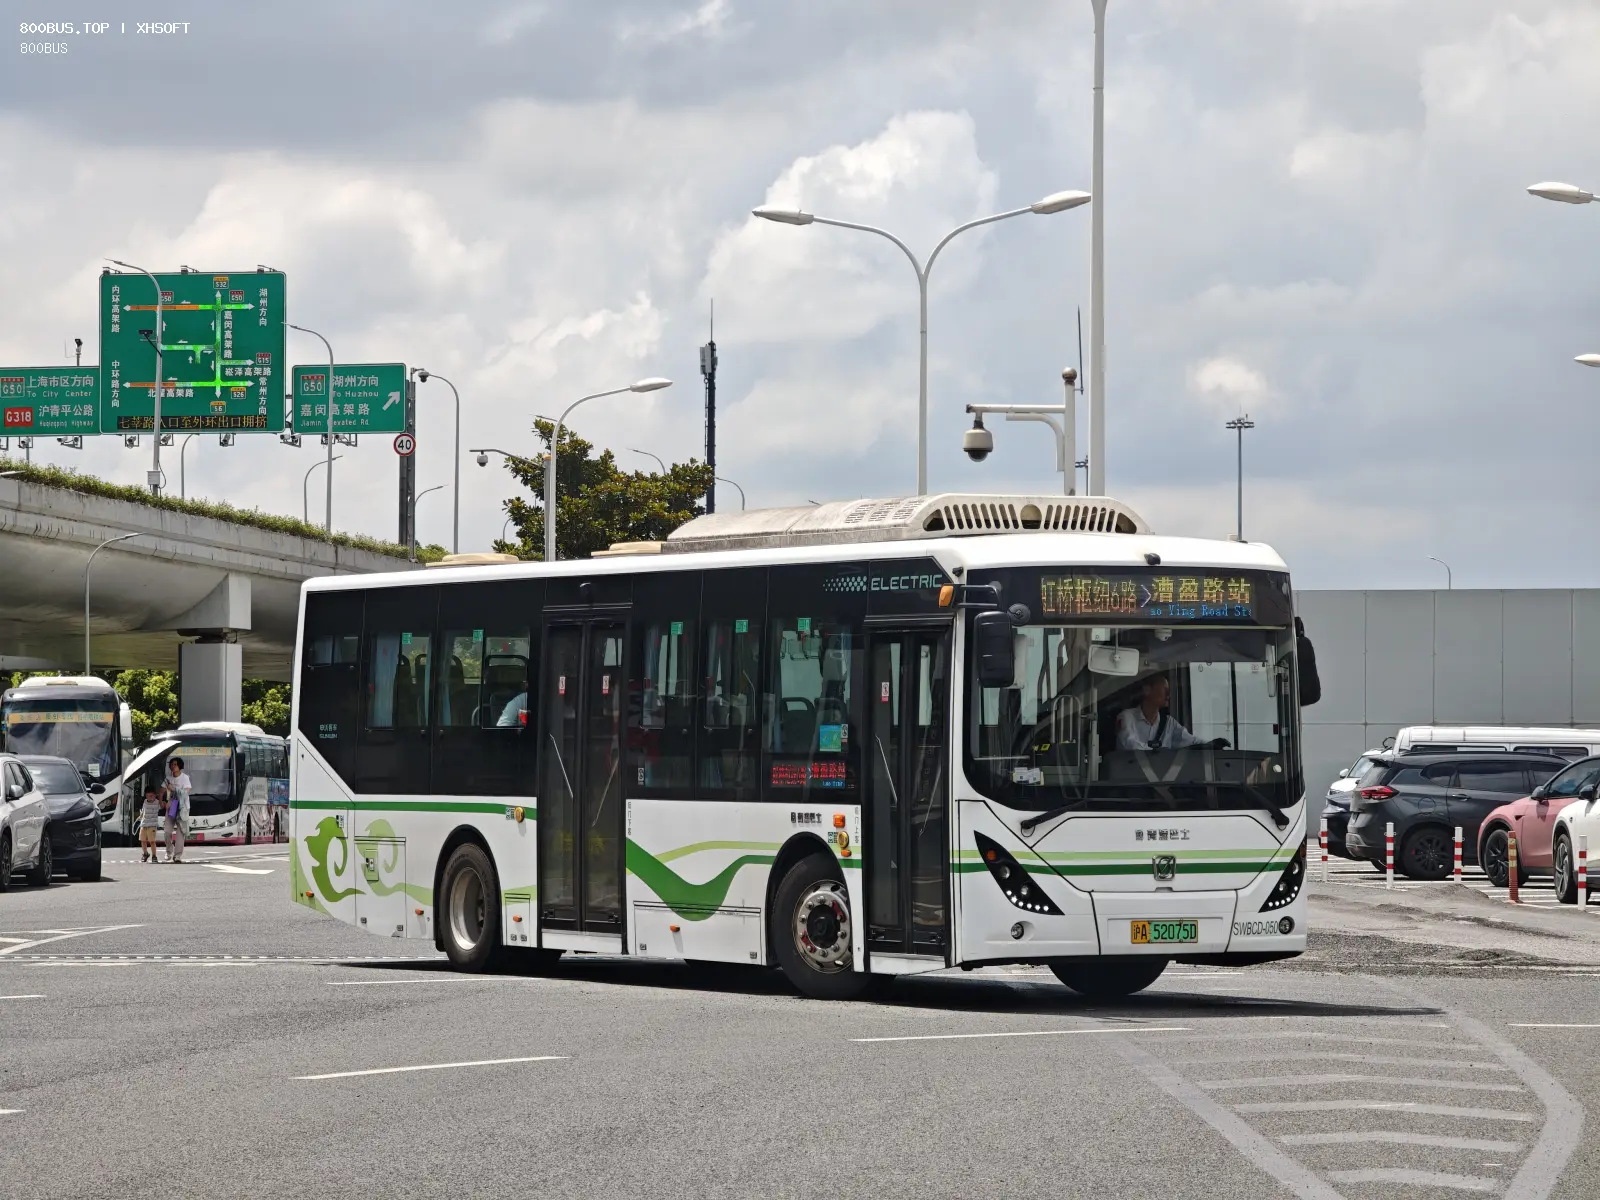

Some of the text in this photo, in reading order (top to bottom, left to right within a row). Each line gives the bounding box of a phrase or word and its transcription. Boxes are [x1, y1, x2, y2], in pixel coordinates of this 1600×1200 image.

[111, 285, 120, 333] 内环高架路
[259, 288, 268, 327] 湖州方向
[224, 310, 233, 359] 嘉闵高架路
[26, 375, 94, 388] 上海市区方向
[111, 360, 120, 408] 中环路方向
[303, 382, 323, 392] G50
[332, 375, 379, 387] 湖州方向
[2, 384, 22, 395] G50
[43, 390, 59, 398] City
[258, 377, 267, 415] 常州方向
[38, 404, 94, 417] 沪青平公路
[300, 403, 370, 416] 嘉闵高架路
[6, 410, 32, 423] G318
[300, 419, 322, 427] Jiamin
[327, 418, 357, 426] evated
[397, 439, 412, 450] 40
[871, 574, 943, 591] ELECTRIC
[1169, 604, 1196, 618] Ying
[1201, 604, 1229, 616] Road
[1153, 923, 1197, 940] 52075D
[1233, 921, 1278, 936] SWBCD-050
